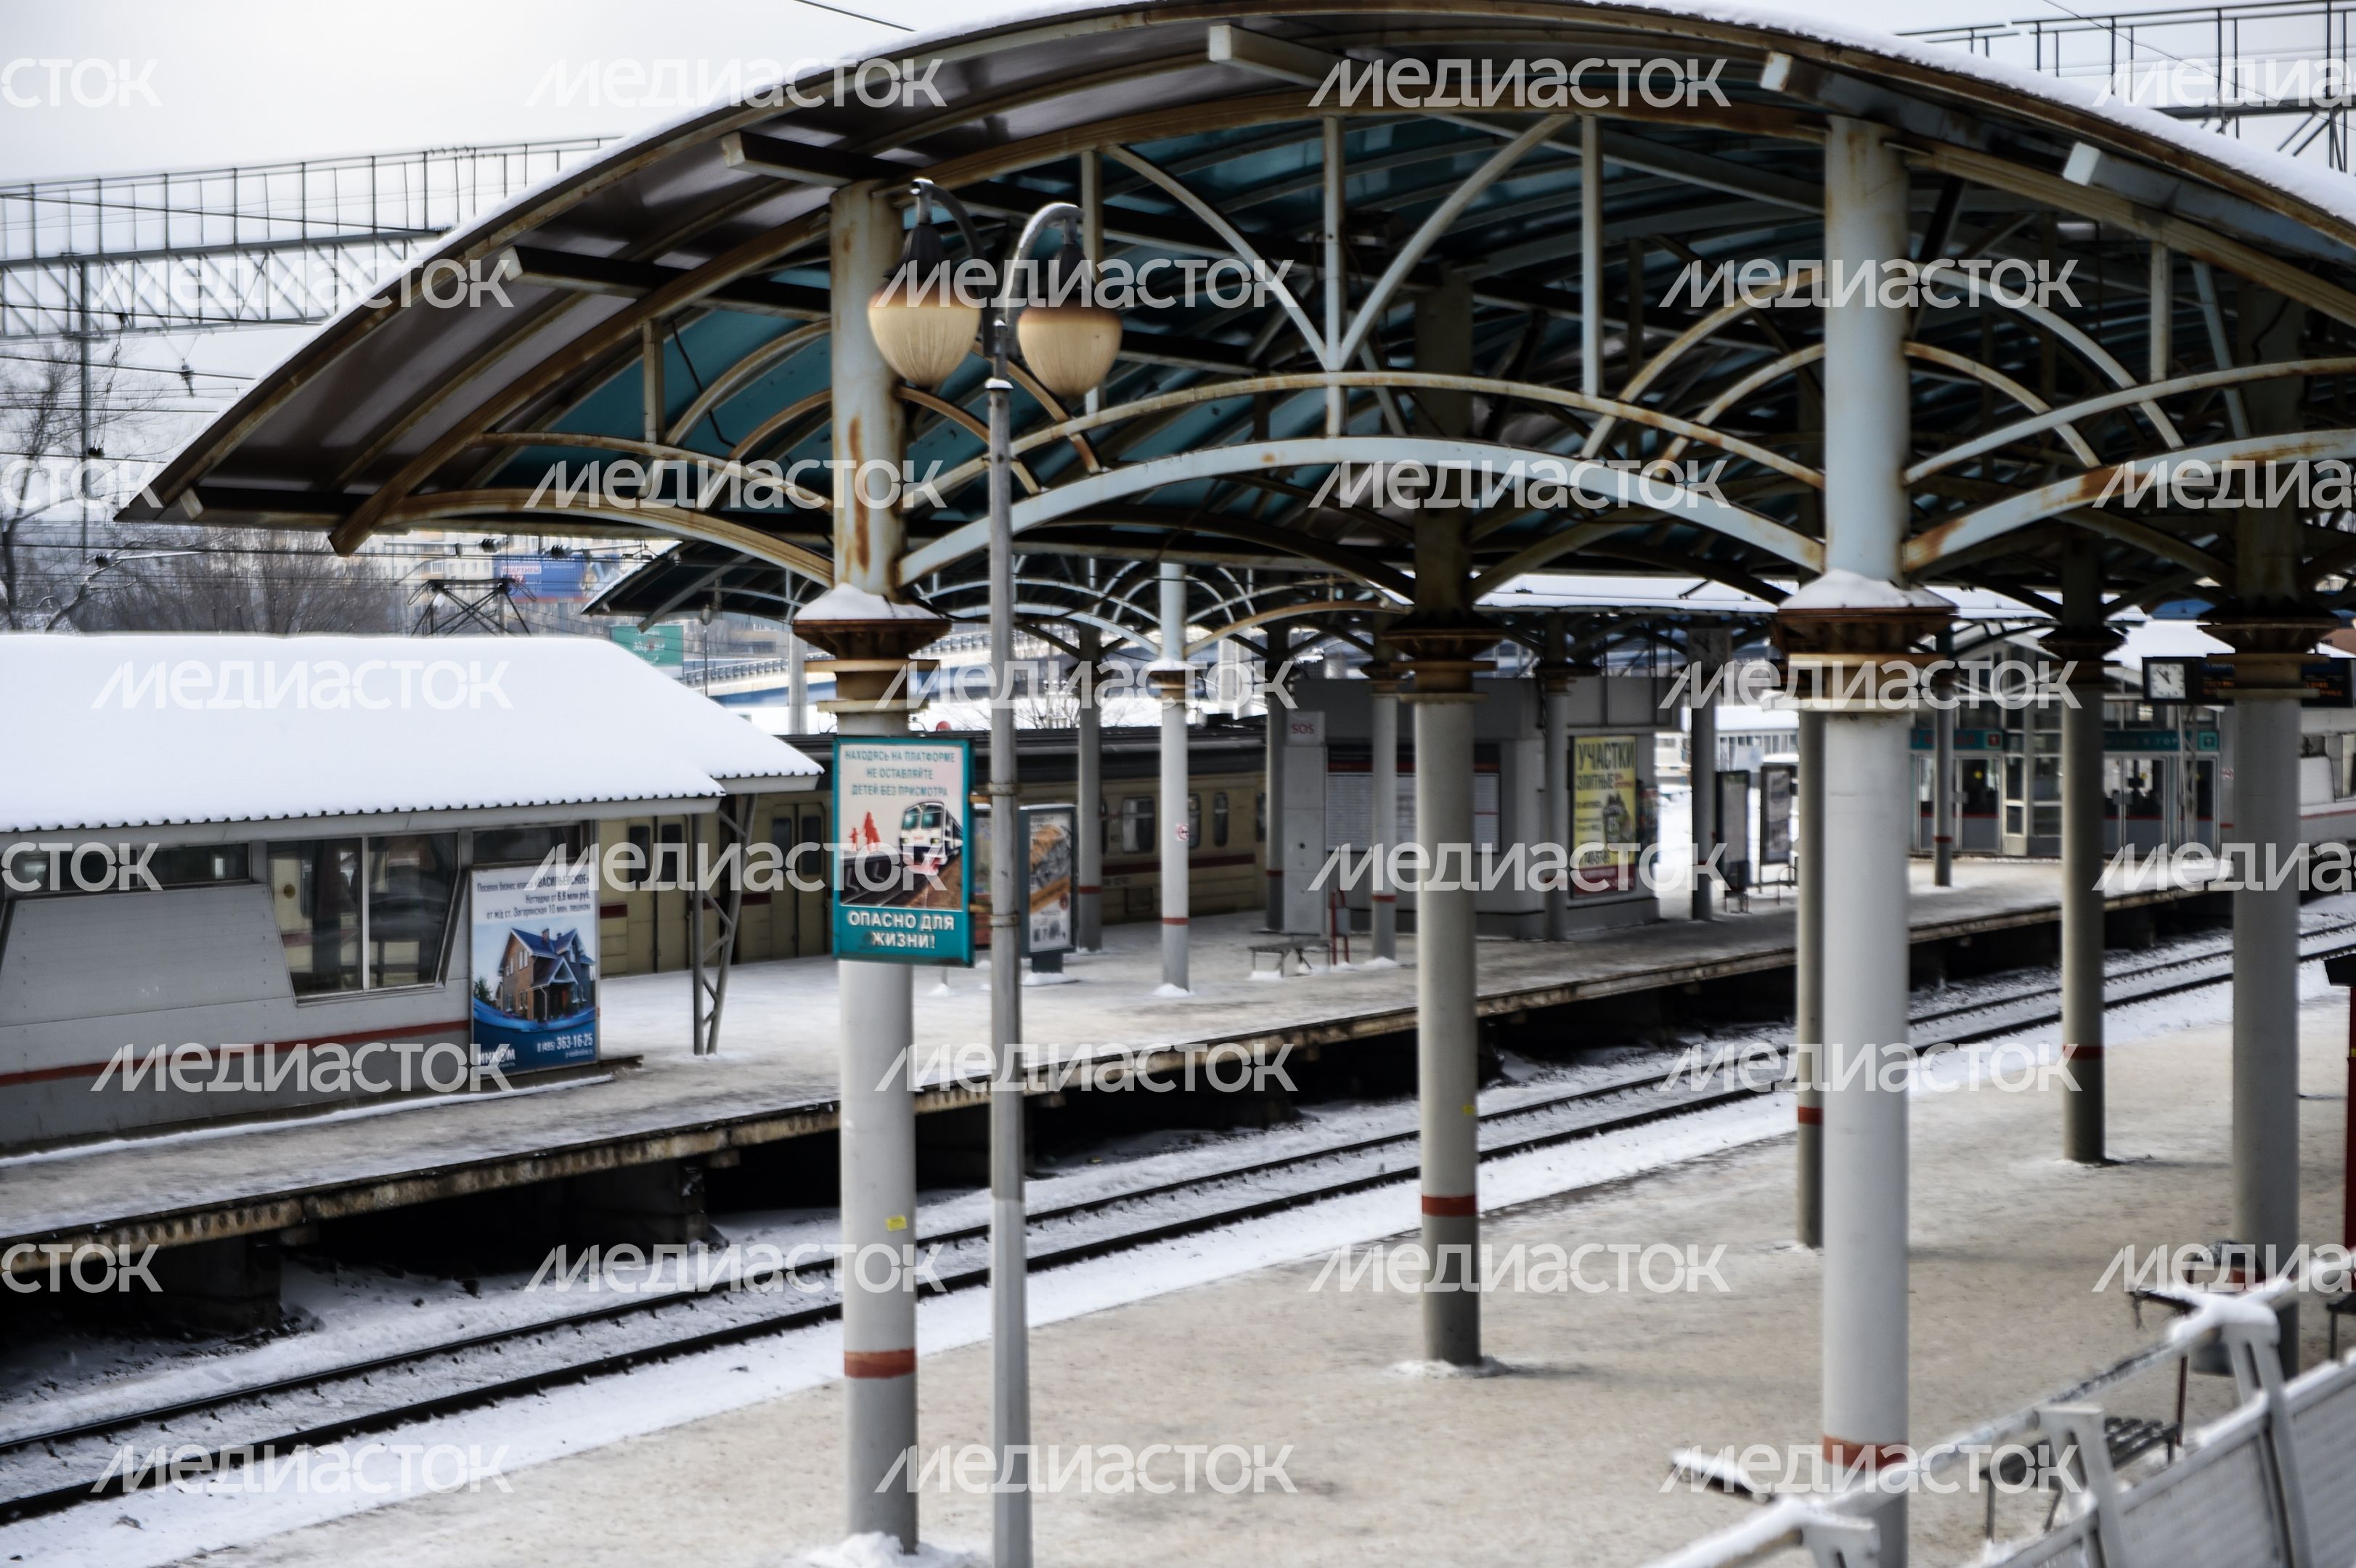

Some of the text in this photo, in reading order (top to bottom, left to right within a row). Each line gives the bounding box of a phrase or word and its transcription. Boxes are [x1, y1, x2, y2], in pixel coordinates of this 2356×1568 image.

[1291, 723, 1315, 735] SOS
[845, 749, 955, 763] НАХОДЯСЬ НА ПЛАТФОРМЕ
[1578, 742, 1634, 771] УЧАСТКИ
[866, 767, 934, 780] НЕ ОСТАВЛЯЙТЕ
[851, 783, 948, 796] ДЕТЕЙ БЕЗ ПРИСМОТРА
[847, 910, 955, 931] ОПАСНО ДЛЯ
[871, 931, 936, 949] ЖИЗНИ!
[556, 1033, 593, 1050] 363-16-25
